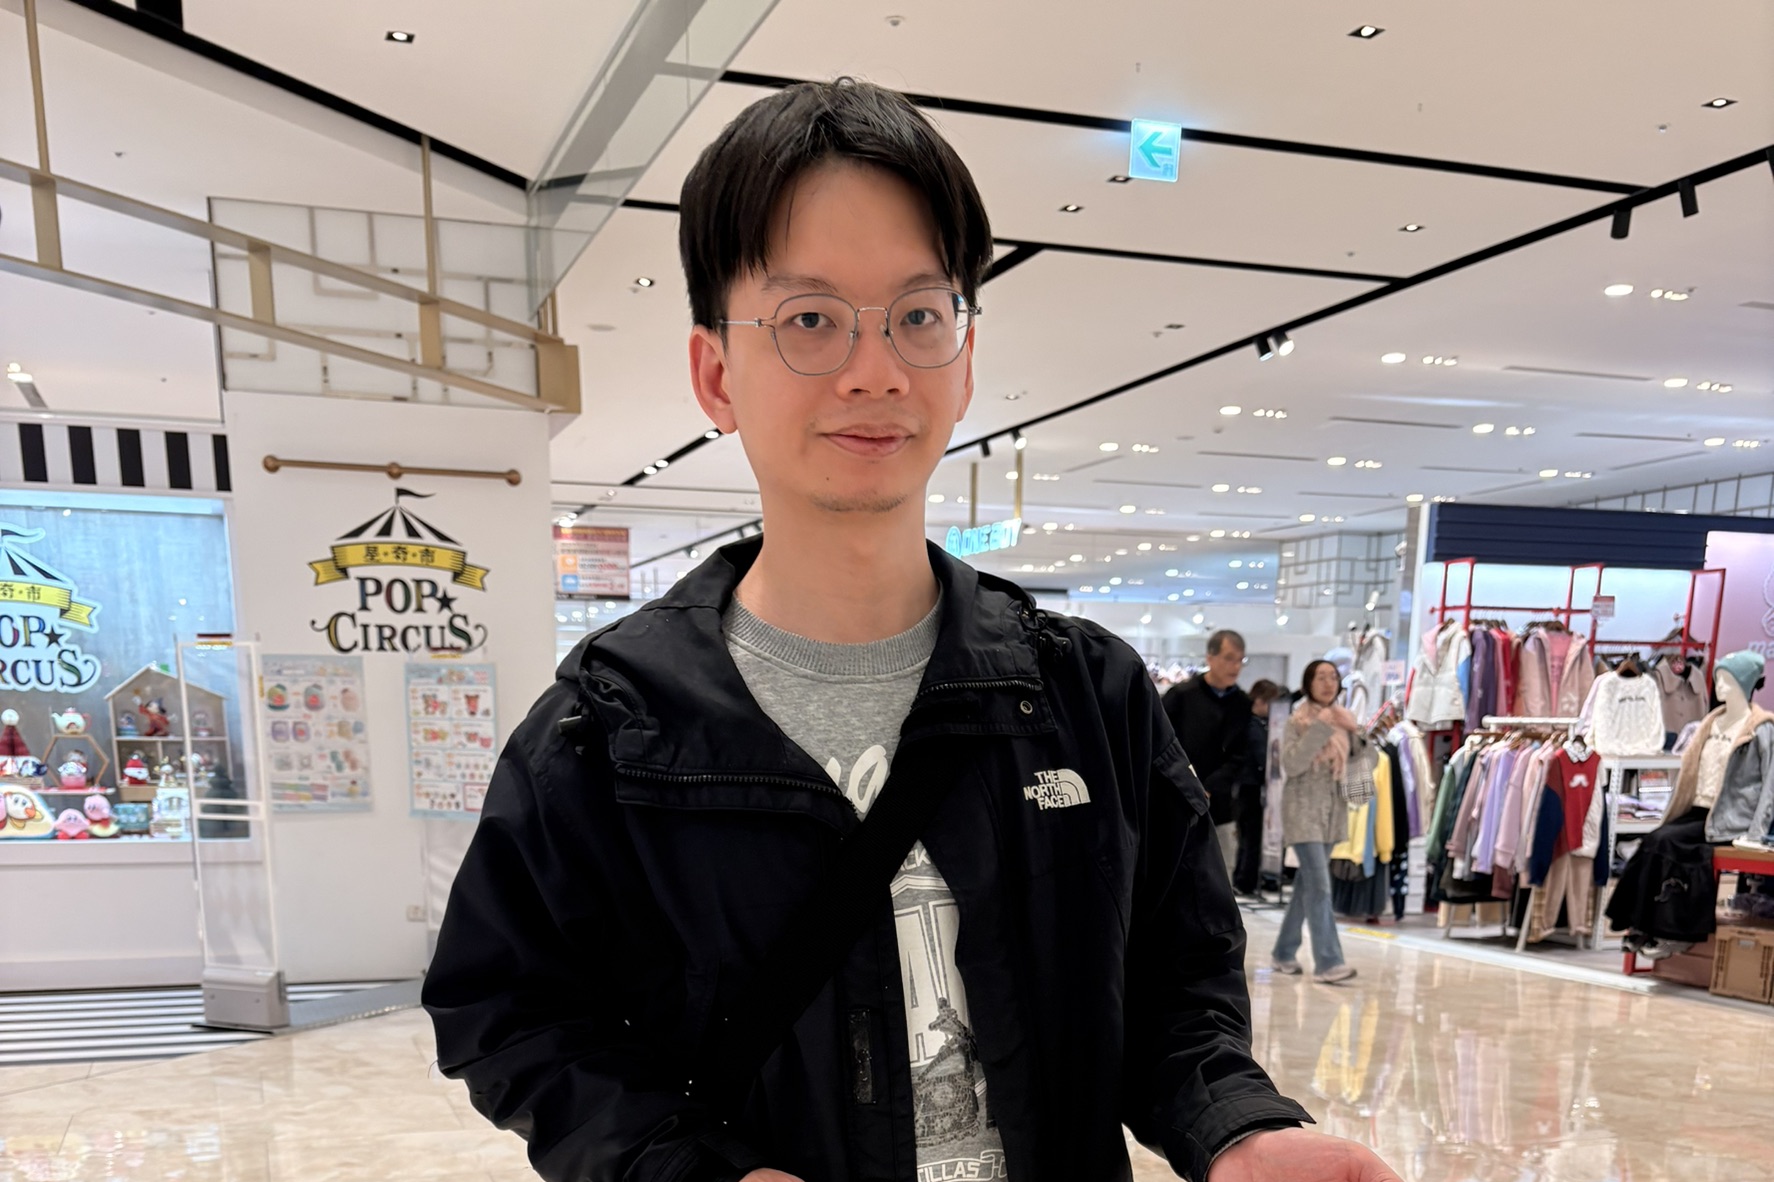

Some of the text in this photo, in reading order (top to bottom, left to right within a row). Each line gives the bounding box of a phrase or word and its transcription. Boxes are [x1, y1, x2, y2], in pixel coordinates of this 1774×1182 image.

[355, 576, 438, 614] POP
[310, 612, 488, 654] CIRCUS
[1034, 770, 1059, 783] THE
[1023, 782, 1061, 800] NORTH
[1037, 795, 1065, 810] FACE
